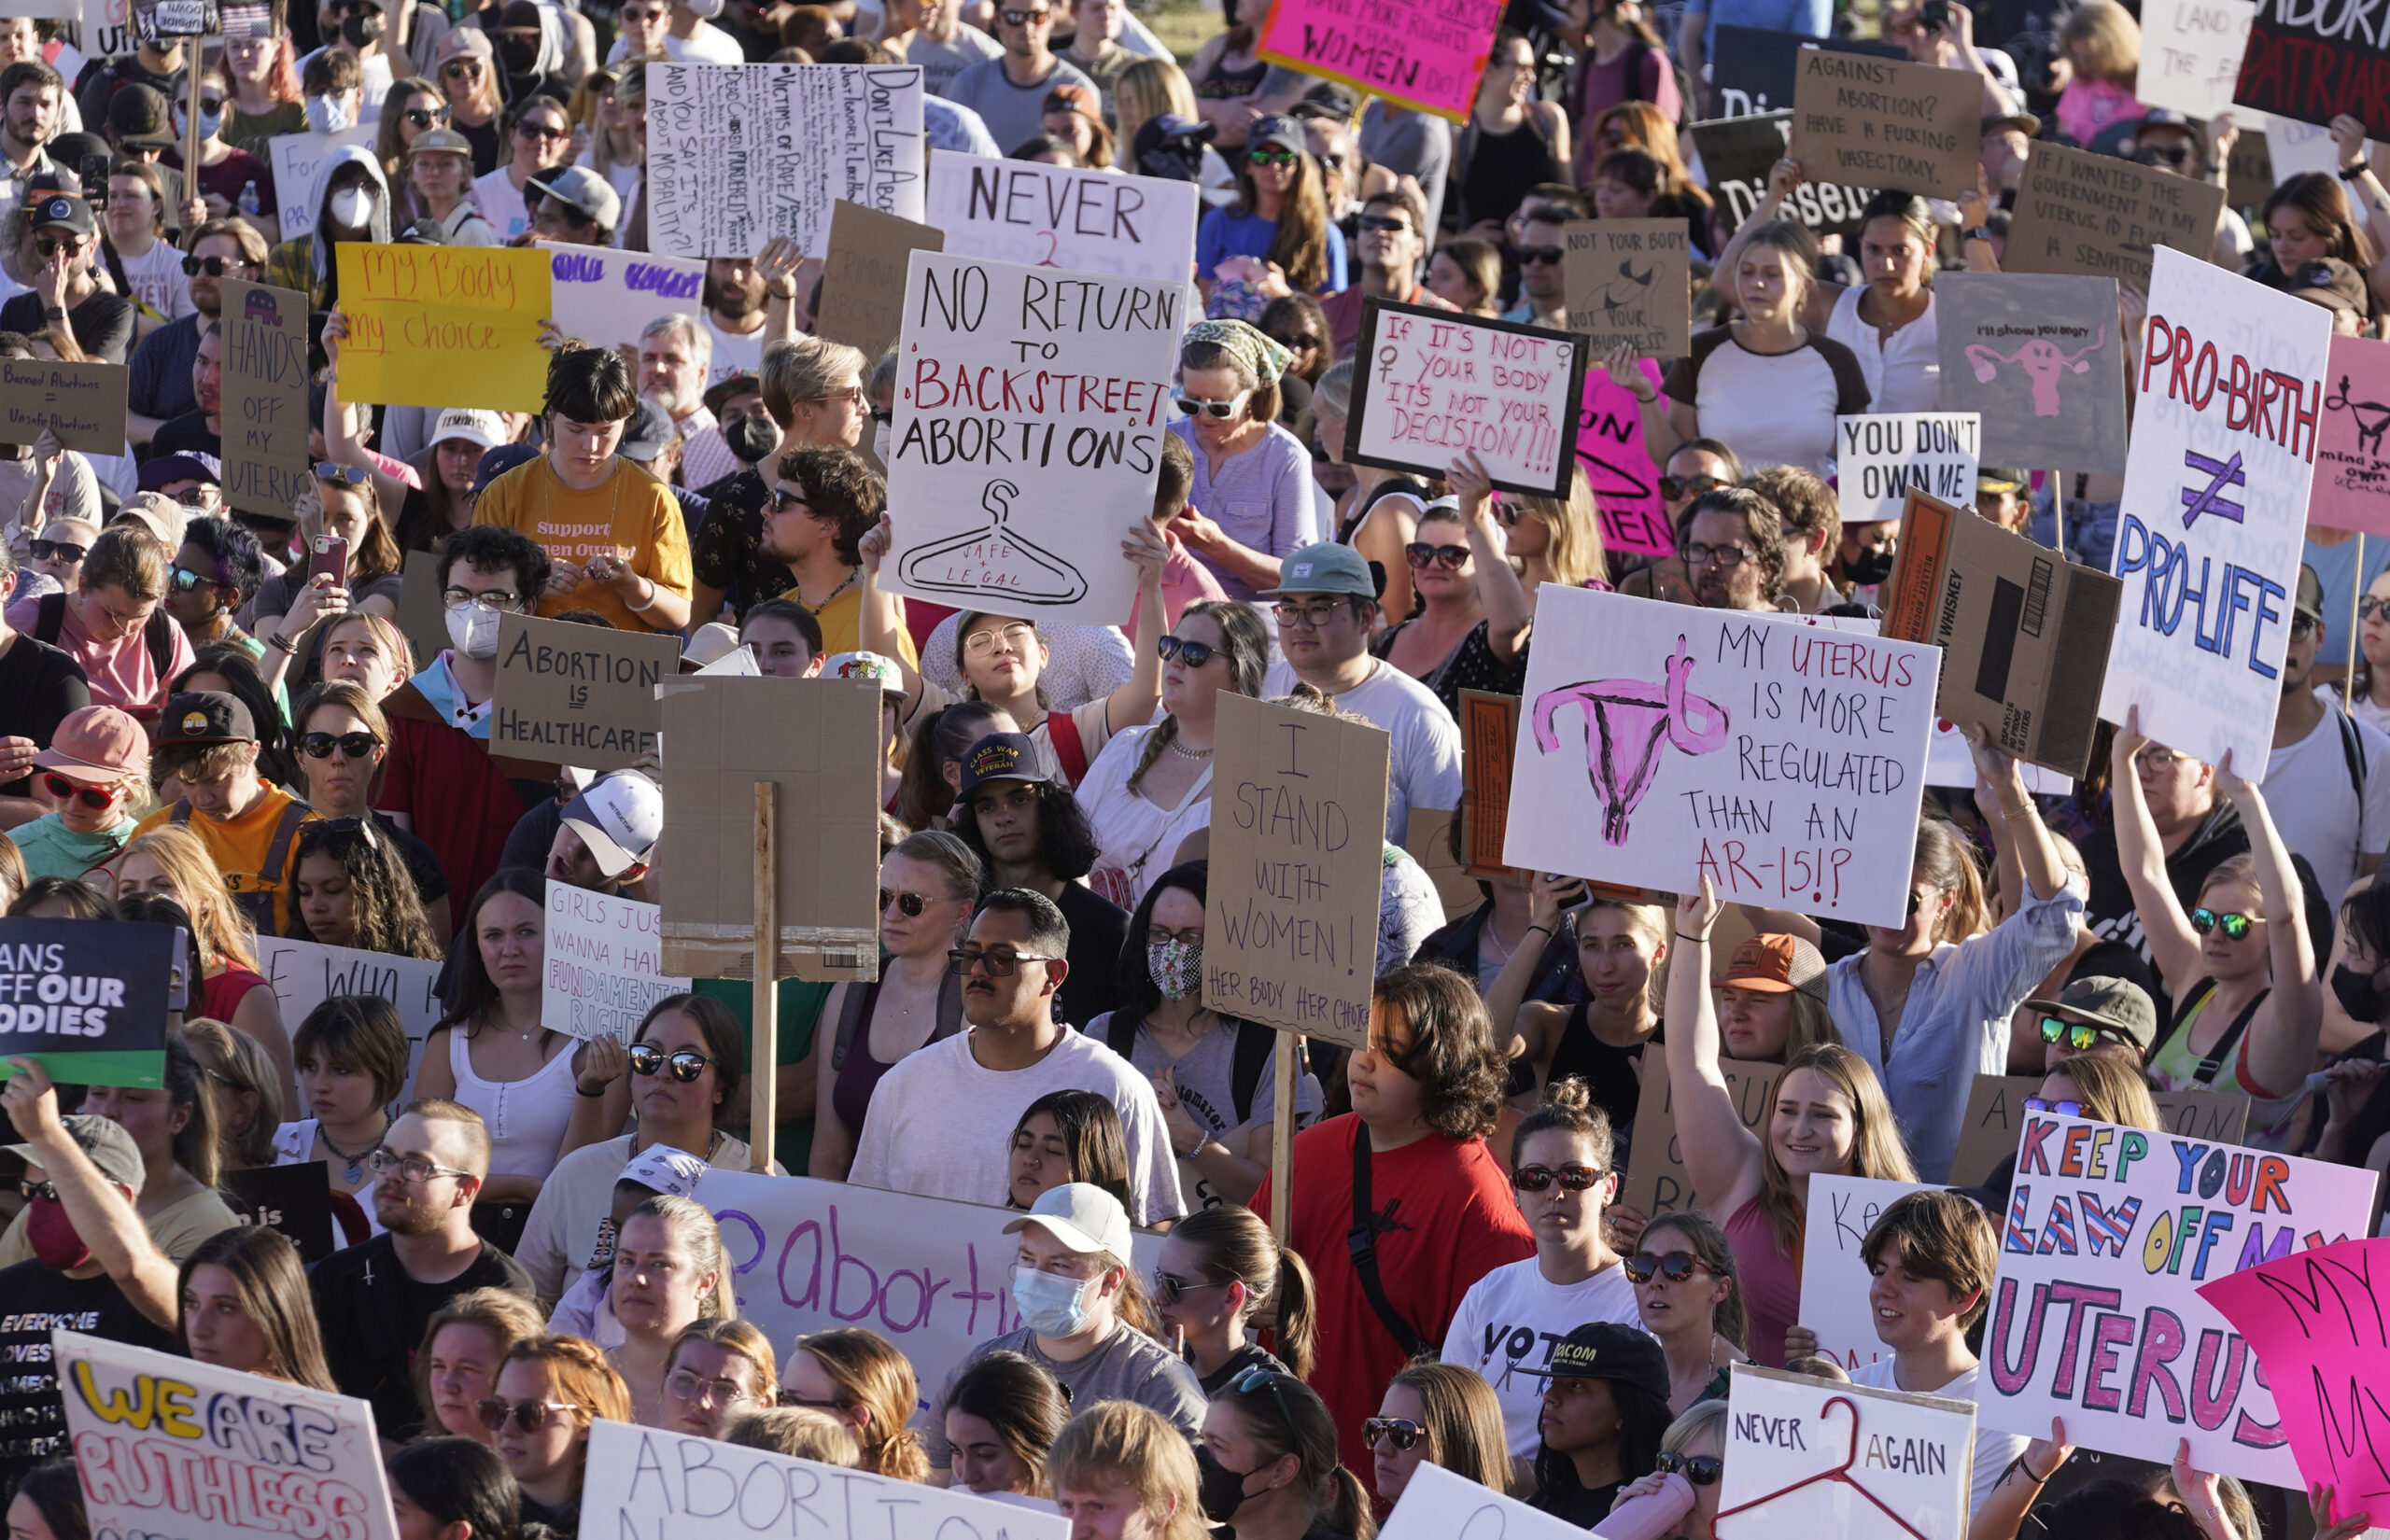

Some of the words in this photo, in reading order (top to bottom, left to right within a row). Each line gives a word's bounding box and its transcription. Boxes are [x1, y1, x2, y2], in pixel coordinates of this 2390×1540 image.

[2174, 2, 2230, 34] LAND
[665, 64, 687, 96] AND
[841, 66, 860, 94] JUST
[1303, 24, 1420, 87] WOMEN
[1425, 67, 1468, 104] DO!
[1807, 56, 1899, 84] AGAINST
[2162, 47, 2199, 77] THE
[724, 72, 742, 102] DEAD
[772, 73, 795, 131] VICTIMS
[867, 68, 921, 127] DON'T
[1836, 87, 1937, 122] ABORTION?
[650, 99, 670, 147] ABOUT
[671, 97, 696, 131] YOU
[844, 97, 864, 138] IGNORE
[776, 135, 793, 151] OF
[875, 129, 919, 166] LIKE
[1806, 113, 1846, 134] HAVE
[1863, 122, 1875, 138] A
[1884, 123, 1956, 152] FUCKING
[680, 136, 697, 169] SAY
[846, 158, 862, 181] LIKE
[1836, 147, 1942, 185] VASECTOMY.
[680, 173, 698, 214] IT'S
[728, 151, 748, 212] MURDERED
[2036, 149, 2053, 170] IF
[2057, 156, 2063, 174] I
[2071, 160, 2143, 193] WANTED
[2150, 181, 2186, 206] THE
[651, 153, 692, 251] MORALITY?!
[968, 166, 1145, 243] NEVER
[2032, 175, 2139, 216] GOVERNMENT
[2148, 204, 2165, 225] IN
[2172, 212, 2197, 233] MY
[2034, 200, 2100, 231] UTERUS,
[728, 220, 738, 254] RIFLES
[738, 215, 749, 254] ASSAULT
[746, 211, 755, 232] WITH
[1568, 233, 1597, 251] NOT
[1607, 231, 1643, 251] YOUR
[1649, 231, 1684, 250] BODY
[2046, 235, 2060, 257] A
[429, 249, 515, 311] Body
[921, 265, 988, 332] NO
[1022, 274, 1175, 332] RETURN
[1568, 310, 1596, 329] NOT
[1607, 309, 1647, 328] YOUR
[1996, 325, 2035, 336] show
[2037, 325, 2059, 337] you
[2059, 327, 2089, 338] angry
[229, 320, 304, 389] HANDS
[1010, 340, 1059, 362] TO
[1428, 322, 1474, 352] IT'S
[1491, 333, 1546, 361] NOT
[3, 363, 45, 386] Banned
[50, 371, 100, 389] Abortions
[1416, 349, 1477, 384] YOUR
[1493, 365, 1551, 394] BODY
[2142, 314, 2321, 464] PRO-BIRTH
[244, 397, 285, 423] OFF
[915, 358, 1170, 427] BACKSTREET
[1449, 392, 1488, 413] NOT
[1499, 399, 1552, 426] YOUR
[9, 409, 48, 427] Unsafe
[50, 413, 100, 432] Abortions
[1843, 421, 1903, 455] YOU
[1917, 420, 1976, 455] DON'T
[246, 430, 273, 452] MY
[896, 416, 1156, 474] ABORTIONS
[2319, 450, 2365, 466] mind
[1863, 464, 1931, 499] OWN
[1936, 463, 1965, 498] ME
[2345, 467, 2387, 483] own
[537, 521, 612, 537] Support
[963, 543, 1013, 560] SAFE
[947, 567, 1021, 586] LEGAL
[1939, 568, 1963, 637] WHISKEY
[2116, 512, 2286, 679] PRO-LIFE
[503, 629, 659, 688] ABORTION
[1718, 623, 1770, 670] MY
[1792, 635, 1916, 688] UTERUS
[569, 684, 588, 703] IS
[1754, 681, 1782, 720] IS
[1801, 686, 1898, 738] MORE
[499, 707, 656, 754] HEALTHCARE
[2002, 701, 2014, 746] DSP-KY-16
[2011, 708, 2022, 737] PROOF
[2020, 709, 2032, 739] LITERS
[970, 747, 992, 768] CLASS
[996, 745, 1019, 759] WAR
[1276, 723, 1308, 779] I
[2009, 737, 2017, 749] 90
[2017, 739, 2026, 753] 9.0
[976, 762, 1014, 776] VETERAN
[1737, 735, 1904, 796] REGULATED
[608, 800, 635, 835] INSTRUCTURE
[1232, 782, 1349, 852] STAND
[1680, 790, 1773, 834] THAN
[1805, 803, 1858, 842] AN
[1256, 858, 1329, 904] WITH
[551, 888, 606, 923] GIRLS
[551, 928, 611, 965] WANNA
[36, 973, 126, 1008] OUR
[1209, 966, 1244, 1001] HER
[1250, 976, 1286, 1010] BODY
[1297, 986, 1329, 1021] HER
[1333, 1000, 1371, 1032] CHOICE
[2017, 1116, 2148, 1183] KEEP
[2172, 1140, 2293, 1214] YOUR
[258, 1205, 283, 1226] is
[2004, 1184, 2143, 1258] LAW
[2143, 1205, 2234, 1281] OFF
[2256, 1247, 2389, 1350] MY
[0, 1310, 101, 1333] EVERYONE
[69, 1360, 204, 1439] WE
[207, 1392, 338, 1472] ARE
[1735, 1412, 1807, 1451] NEVER
[1866, 1433, 1946, 1476] AGAIN
[72, 1430, 371, 1540] RUTHLESS
